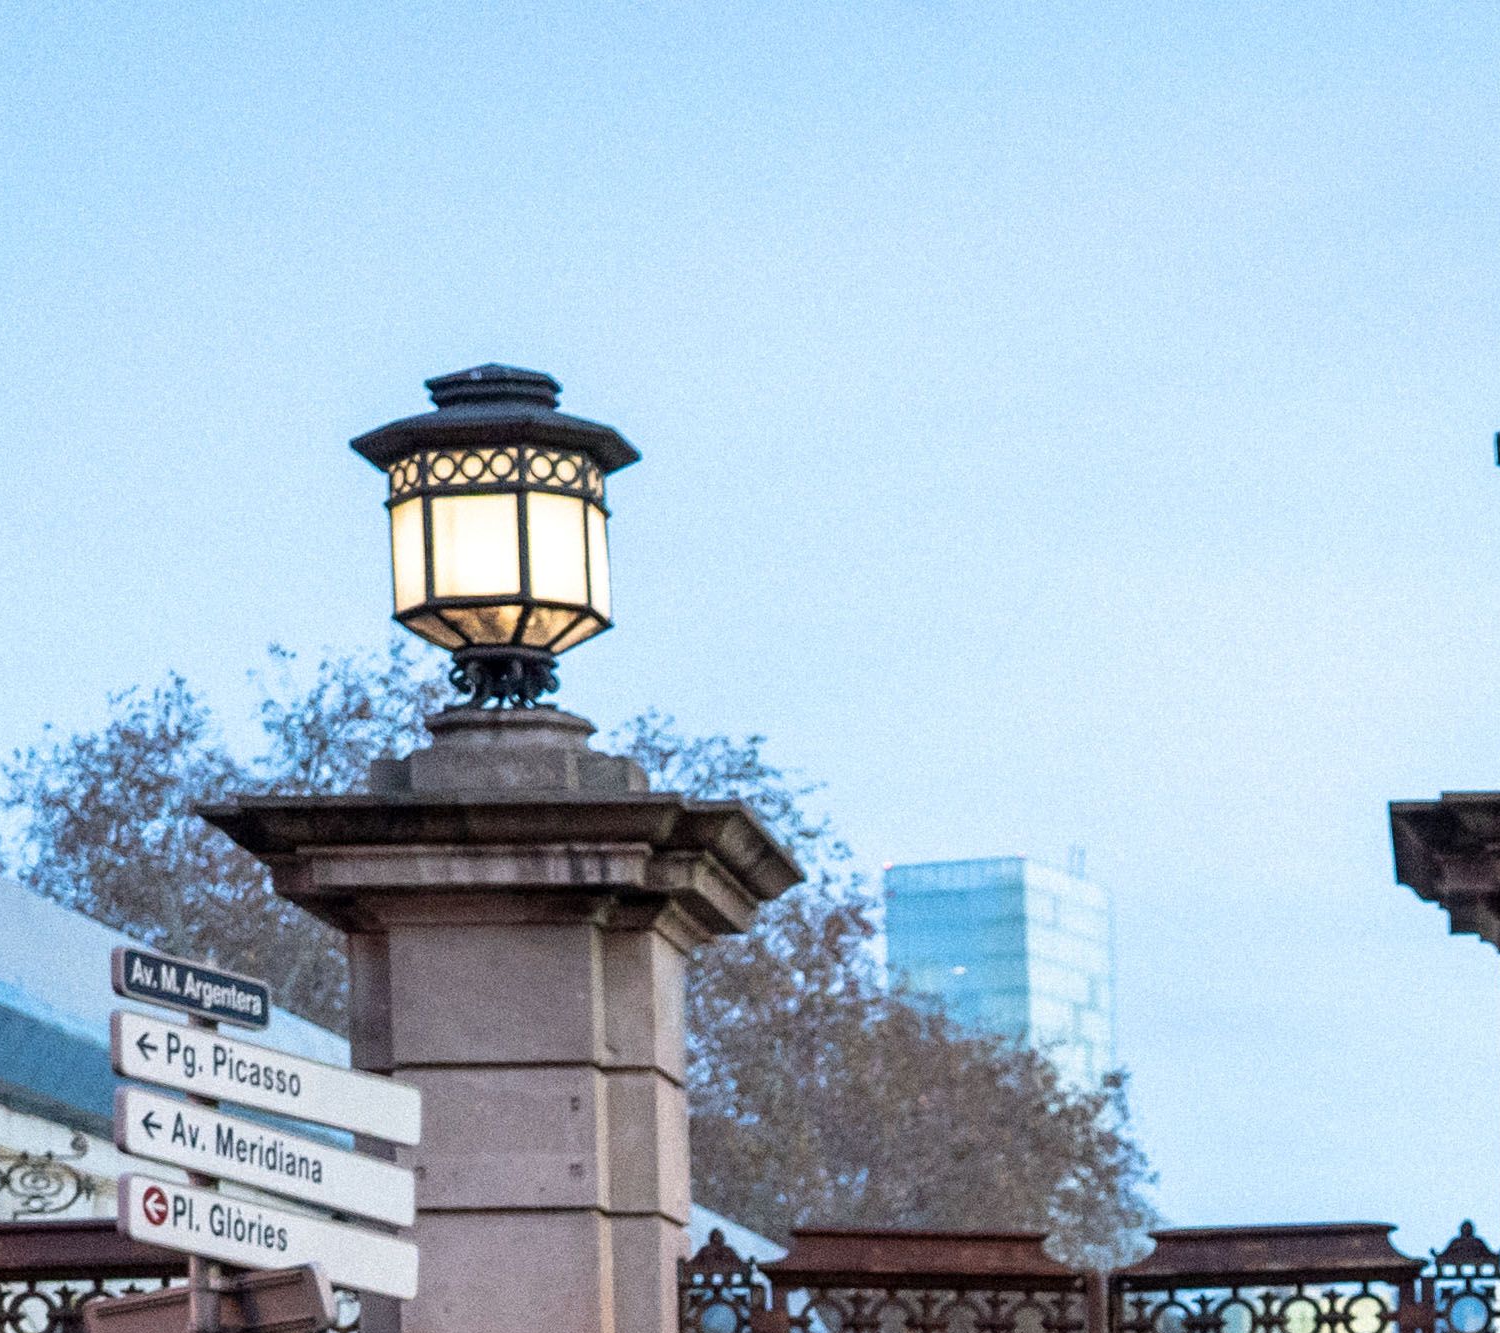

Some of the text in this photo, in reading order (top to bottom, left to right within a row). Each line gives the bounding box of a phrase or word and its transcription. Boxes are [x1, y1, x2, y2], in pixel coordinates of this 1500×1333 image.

[131, 957, 263, 1017] Av. M. Argentera
[166, 1033, 301, 1098] Pg. Picasso
[171, 1112, 324, 1184] Av. Meridiana
[172, 1195, 288, 1252] Pl. Glòries
